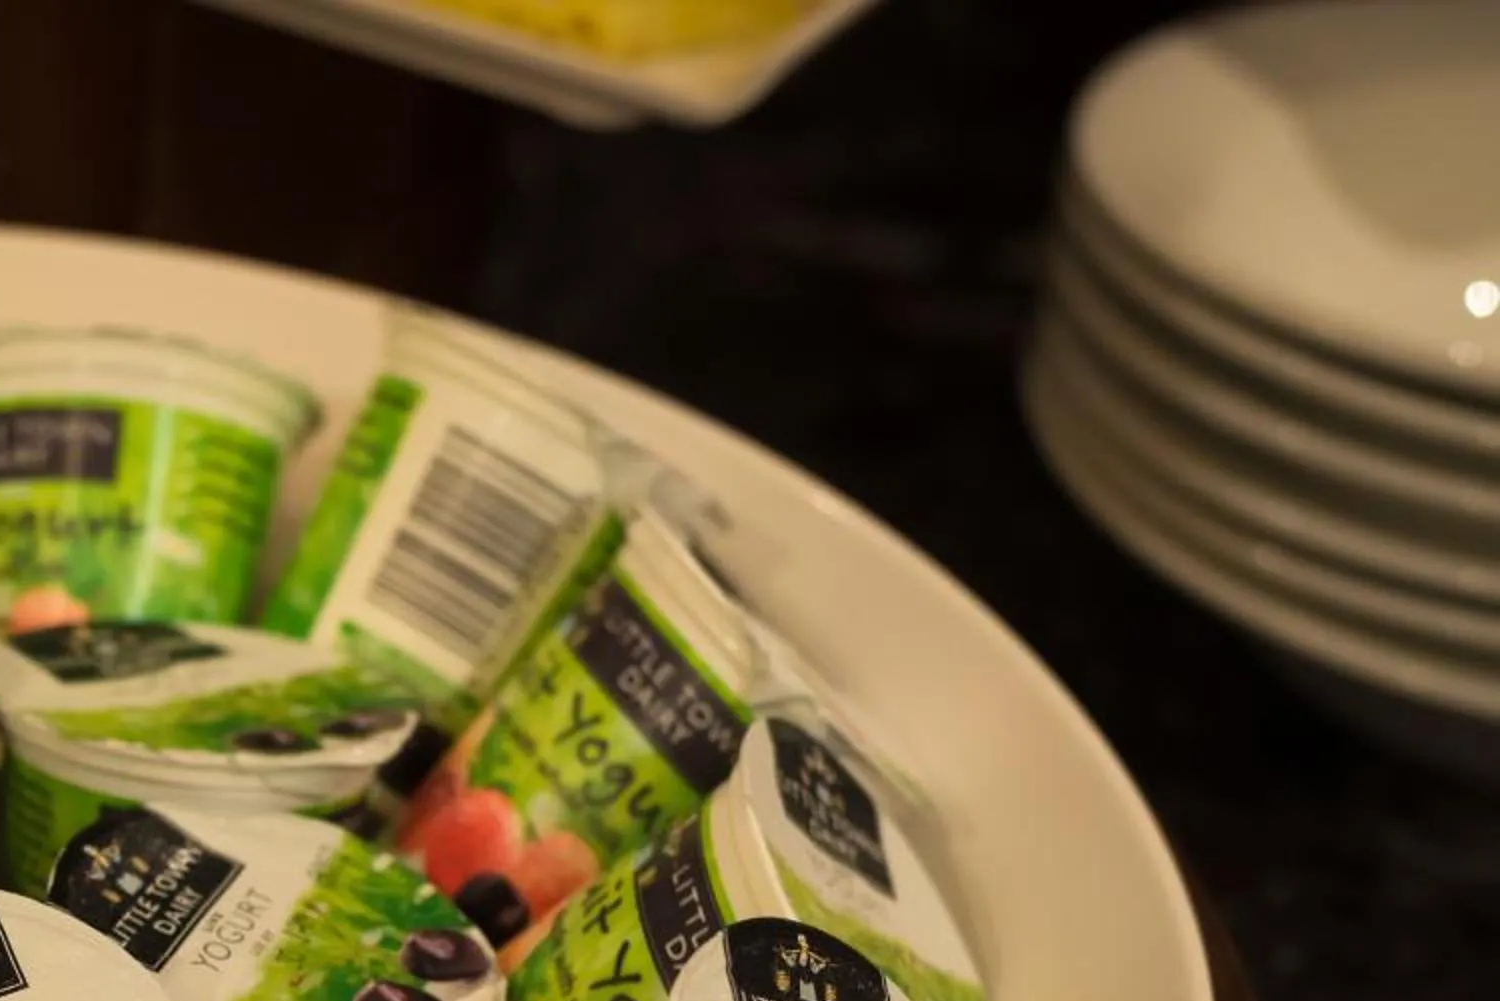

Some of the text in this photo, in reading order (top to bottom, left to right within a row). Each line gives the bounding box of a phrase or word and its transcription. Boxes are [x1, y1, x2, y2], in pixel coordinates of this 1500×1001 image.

[616, 661, 690, 746] DAIRY
[111, 893, 162, 950] LITTLE
[152, 885, 205, 938] DAIRY
[190, 884, 275, 975] YOGURT
